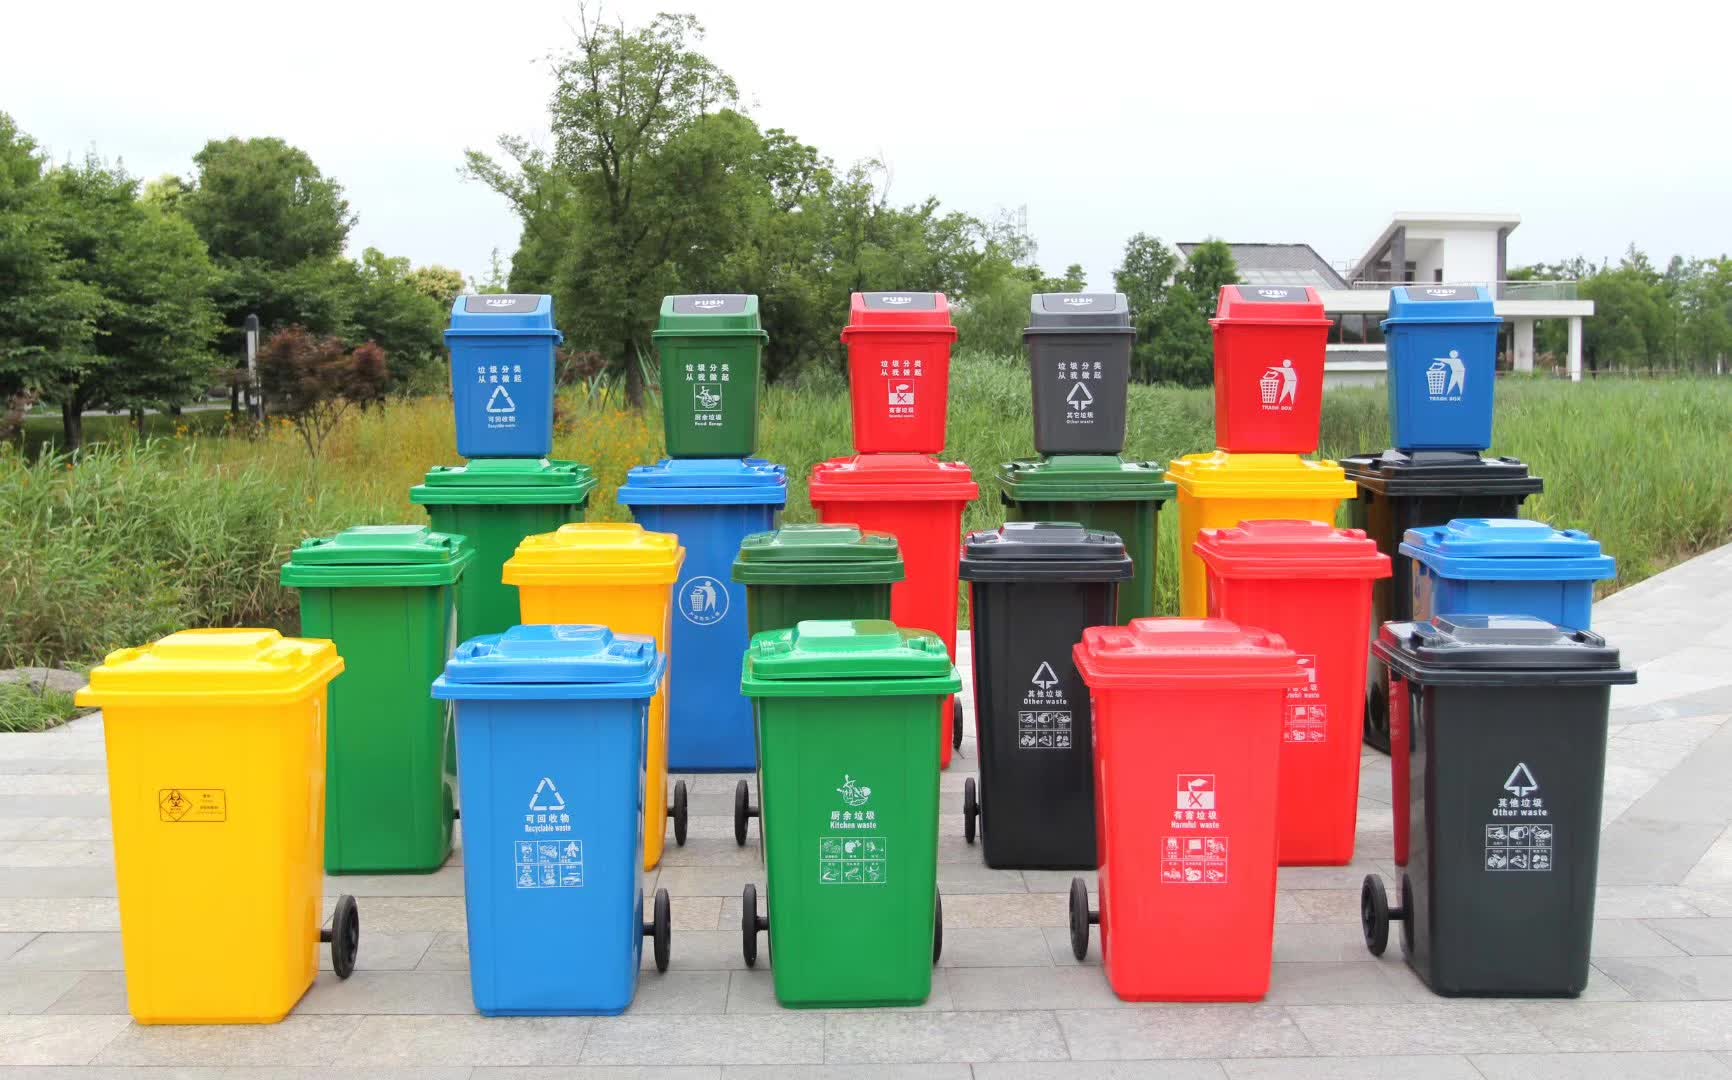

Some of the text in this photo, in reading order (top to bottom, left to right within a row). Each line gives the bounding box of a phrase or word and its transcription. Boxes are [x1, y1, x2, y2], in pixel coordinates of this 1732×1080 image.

[685, 364, 729, 372] 垃圾分类
[1058, 361, 1102, 370] 垃圾分类
[686, 373, 729, 381] 从我做起
[1058, 371, 1102, 380] 从我做起
[1027, 690, 1063, 698] 其他垃圾
[1498, 798, 1543, 807] 其他垃圾
[831, 811, 875, 820] 厨余垃圾
[1173, 810, 1217, 820] 有害垃圾
[1492, 808, 1548, 816] Other waste
[525, 813, 570, 824] 可回收物
[525, 824, 571, 833] Recyclable waste
[830, 821, 877, 829] Kitchen waste
